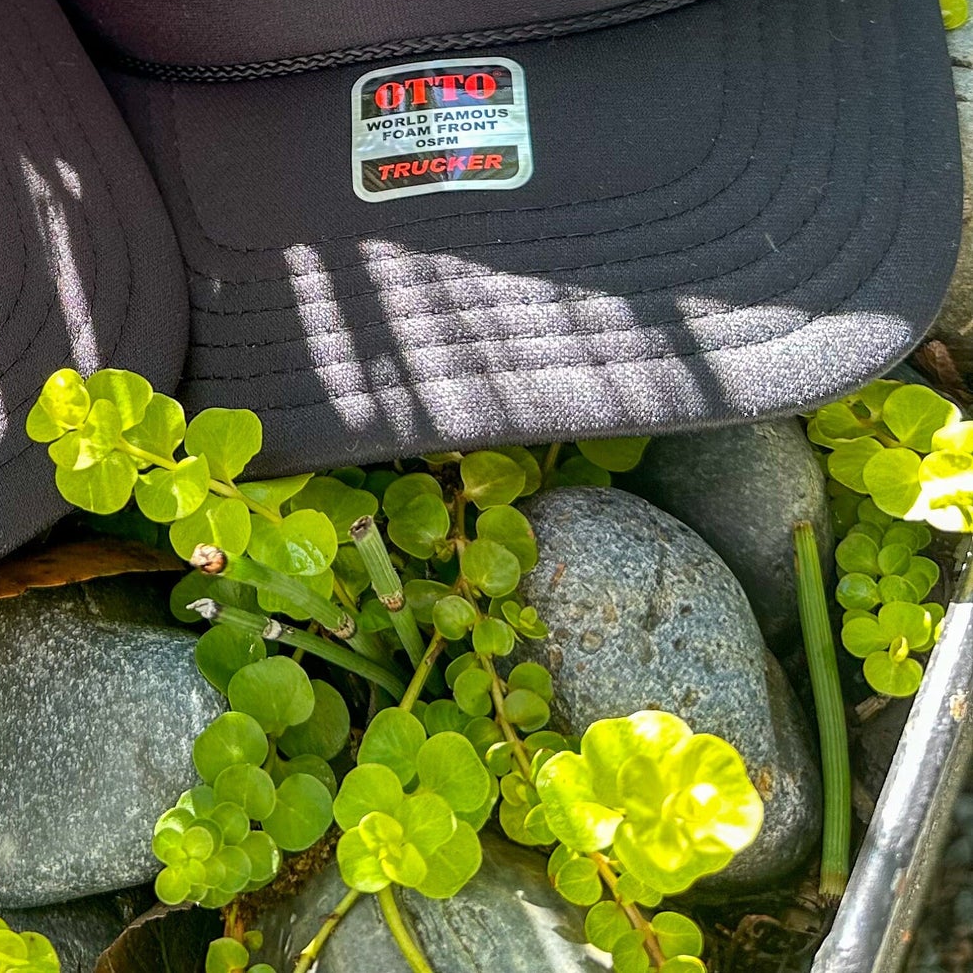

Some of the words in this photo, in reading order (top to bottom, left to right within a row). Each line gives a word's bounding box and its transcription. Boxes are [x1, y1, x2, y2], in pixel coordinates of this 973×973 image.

[374, 72, 497, 109] OTTO
[366, 114, 427, 132] WORLD
[434, 108, 509, 122] FAMOUS
[382, 126, 431, 141] FOAM
[437, 120, 498, 134] FRONT
[415, 136, 459, 148] OSFM
[378, 154, 503, 180] TRUCKER
